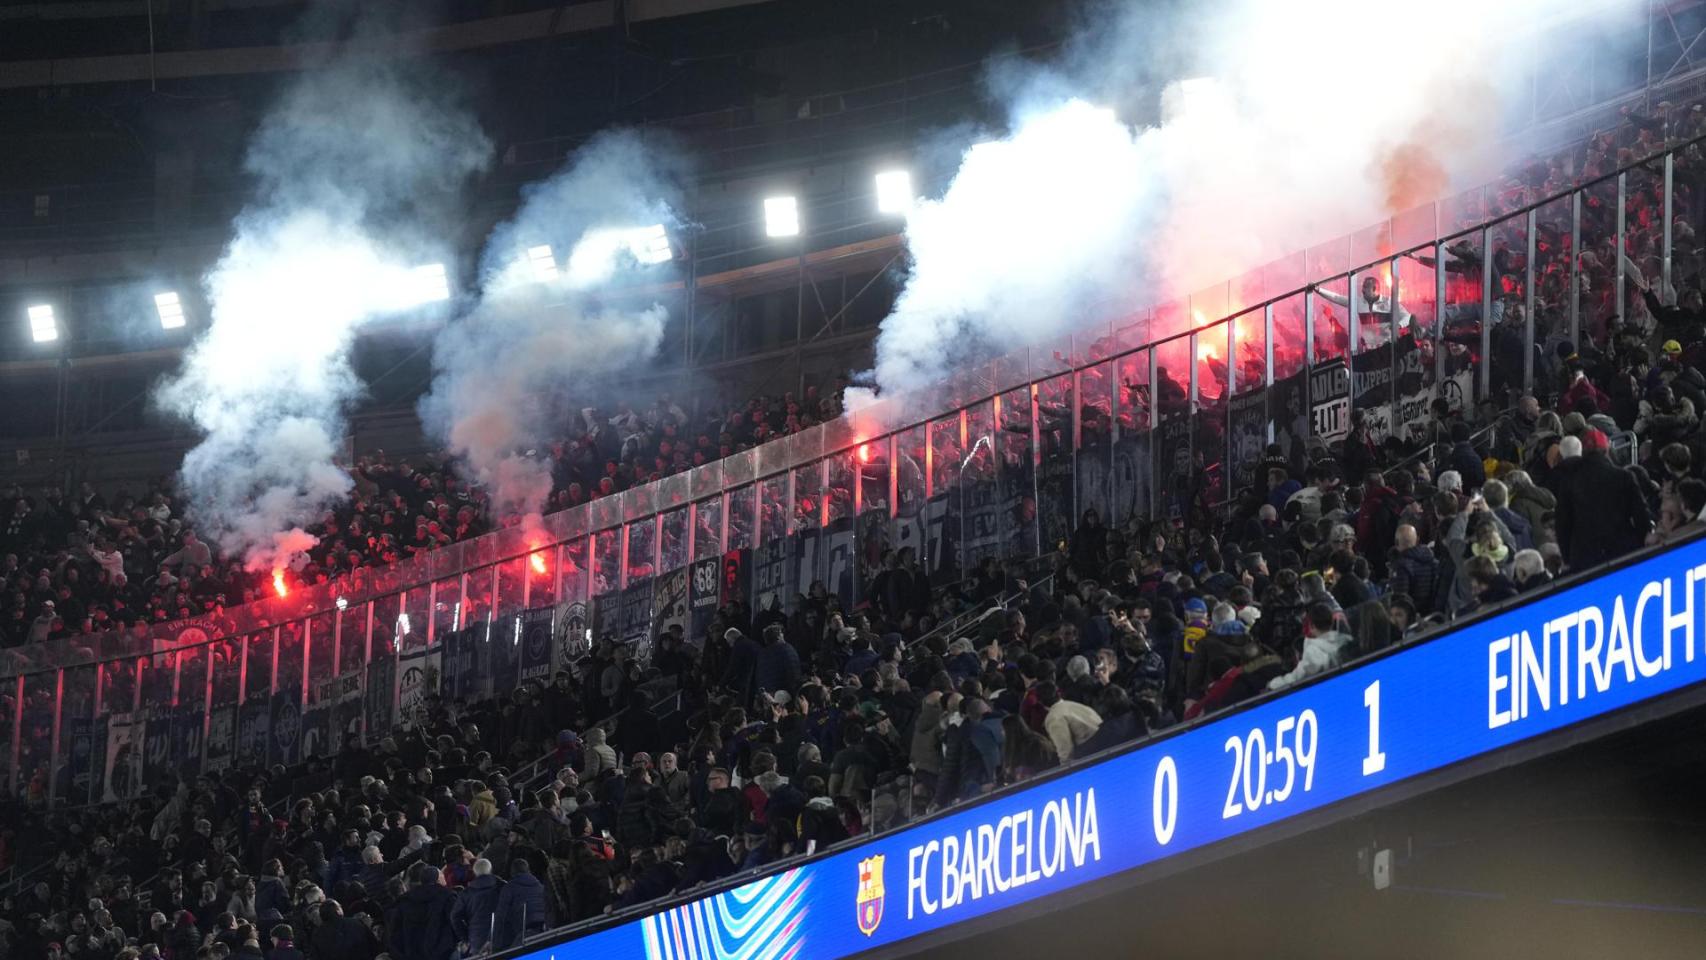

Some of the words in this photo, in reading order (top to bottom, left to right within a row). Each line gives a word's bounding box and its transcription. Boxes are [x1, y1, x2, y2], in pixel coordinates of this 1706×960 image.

[908, 841, 940, 919] FC
[942, 788, 1100, 910] BARCELONA
[1153, 756, 1177, 845] 0
[1223, 710, 1317, 819] 20:59
[1363, 681, 1386, 775] 1
